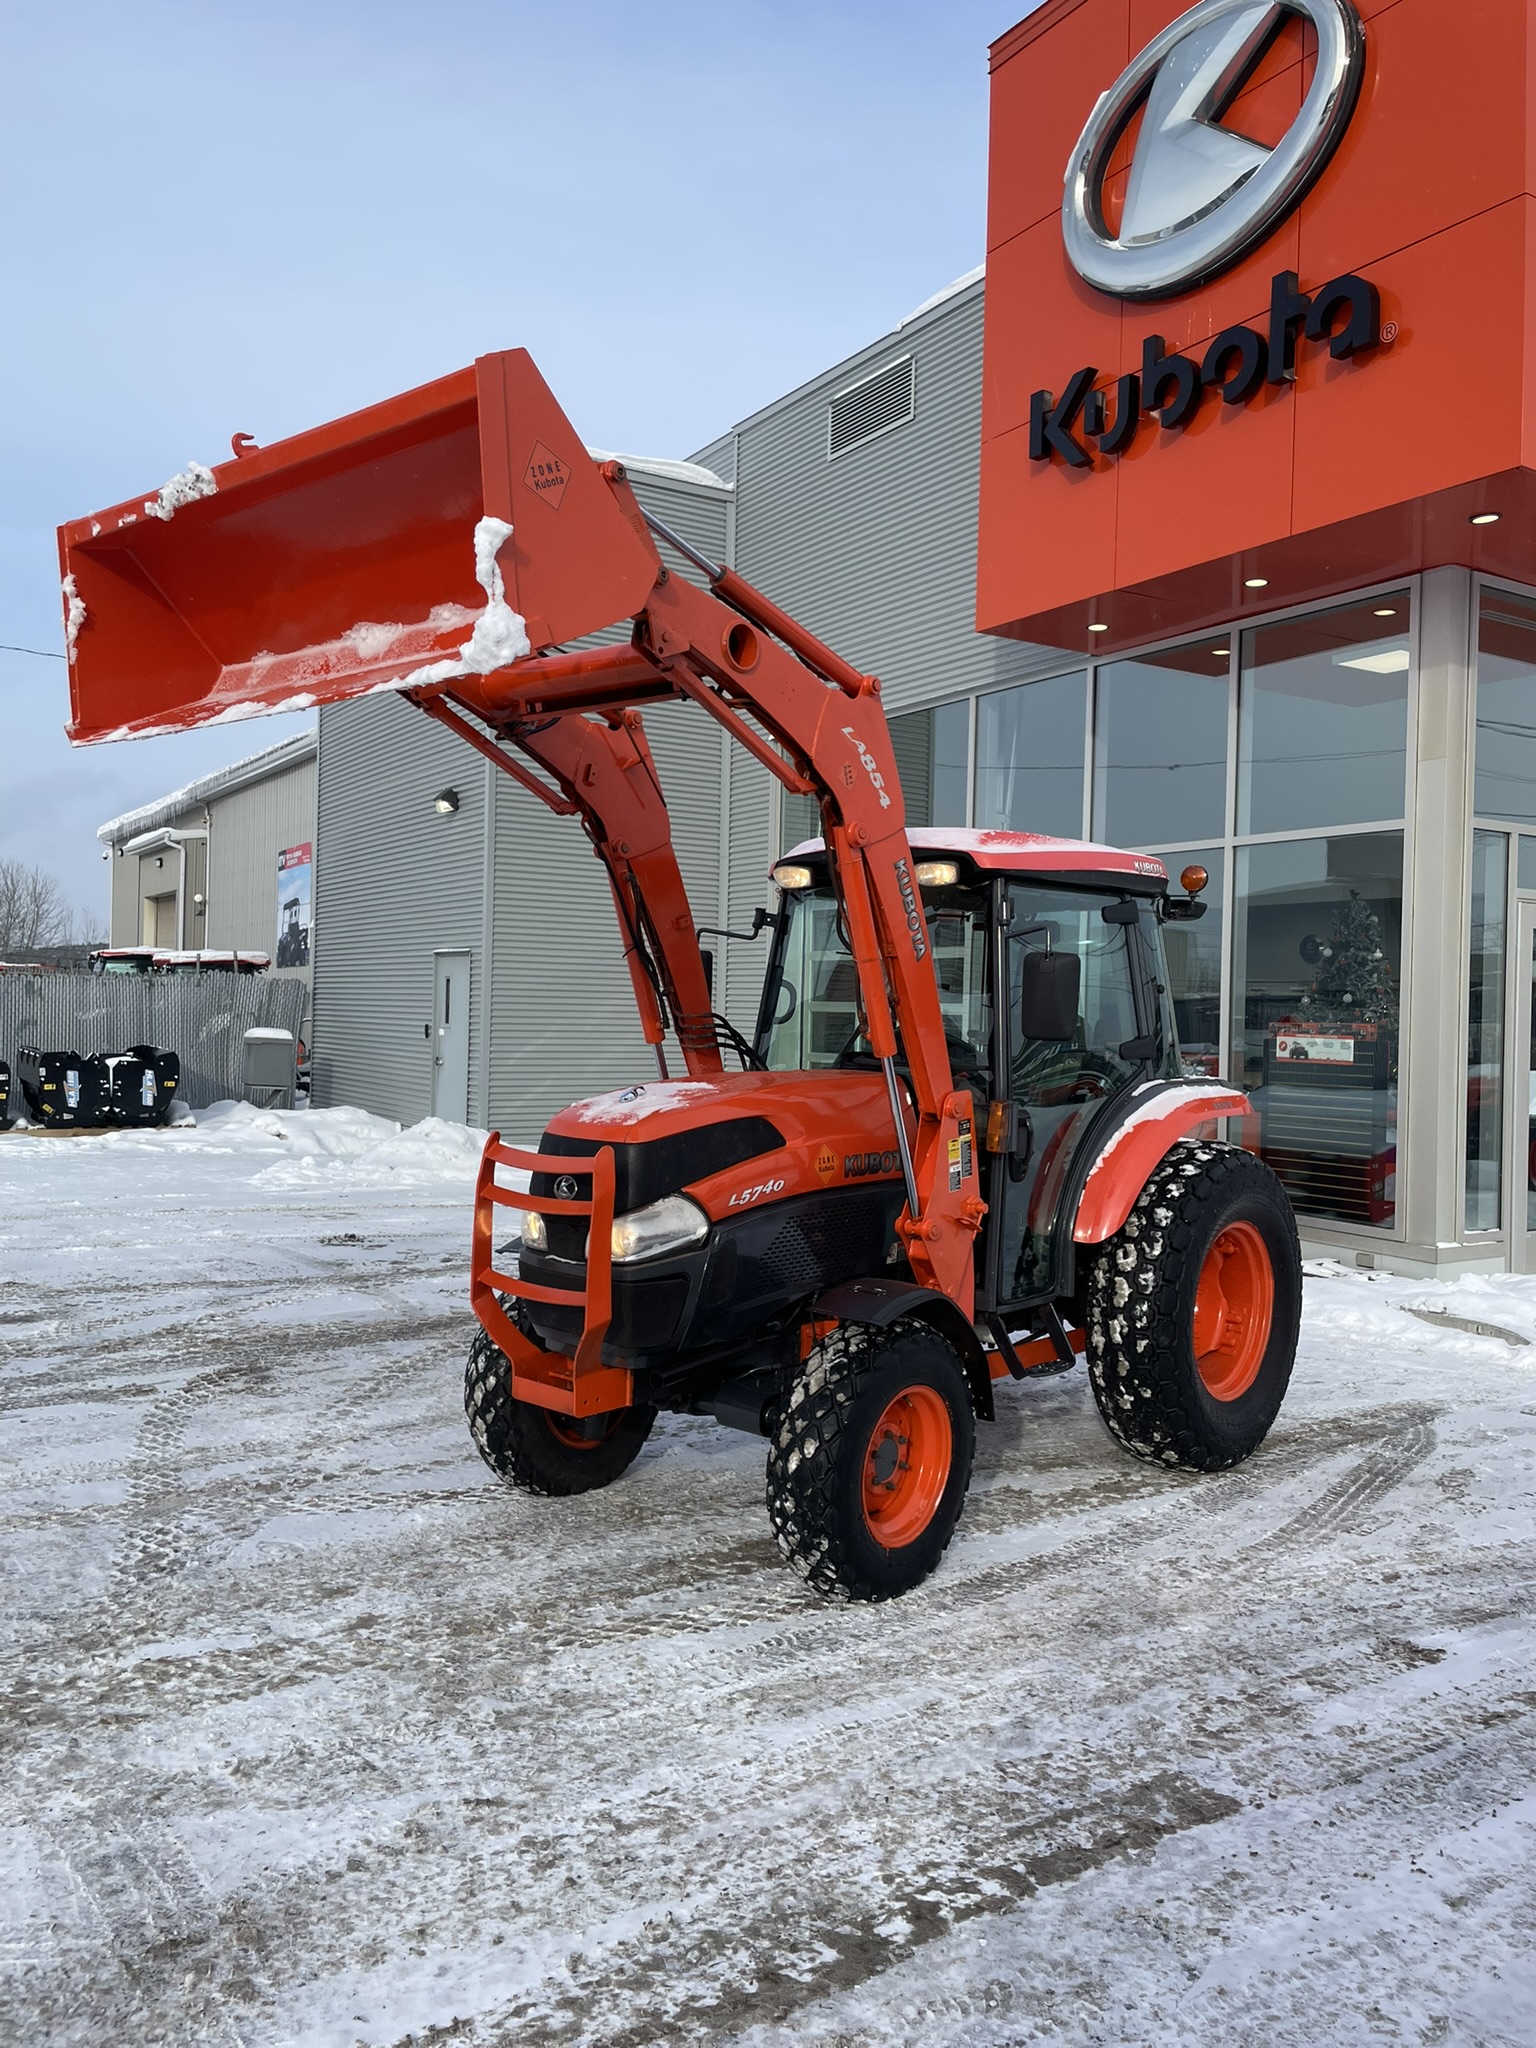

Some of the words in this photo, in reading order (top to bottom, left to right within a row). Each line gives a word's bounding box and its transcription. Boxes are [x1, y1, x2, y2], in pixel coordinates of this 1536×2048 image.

[1029, 270, 1381, 468] Kubota
[530, 461, 561, 477] ZONE
[534, 476, 564, 490] Kubota
[841, 726, 891, 810] LA854
[894, 857, 926, 962] KUBOTA
[818, 1155, 835, 1165] ZONE
[844, 1150, 902, 1178] KUBOT
[728, 1179, 784, 1207] L5740
